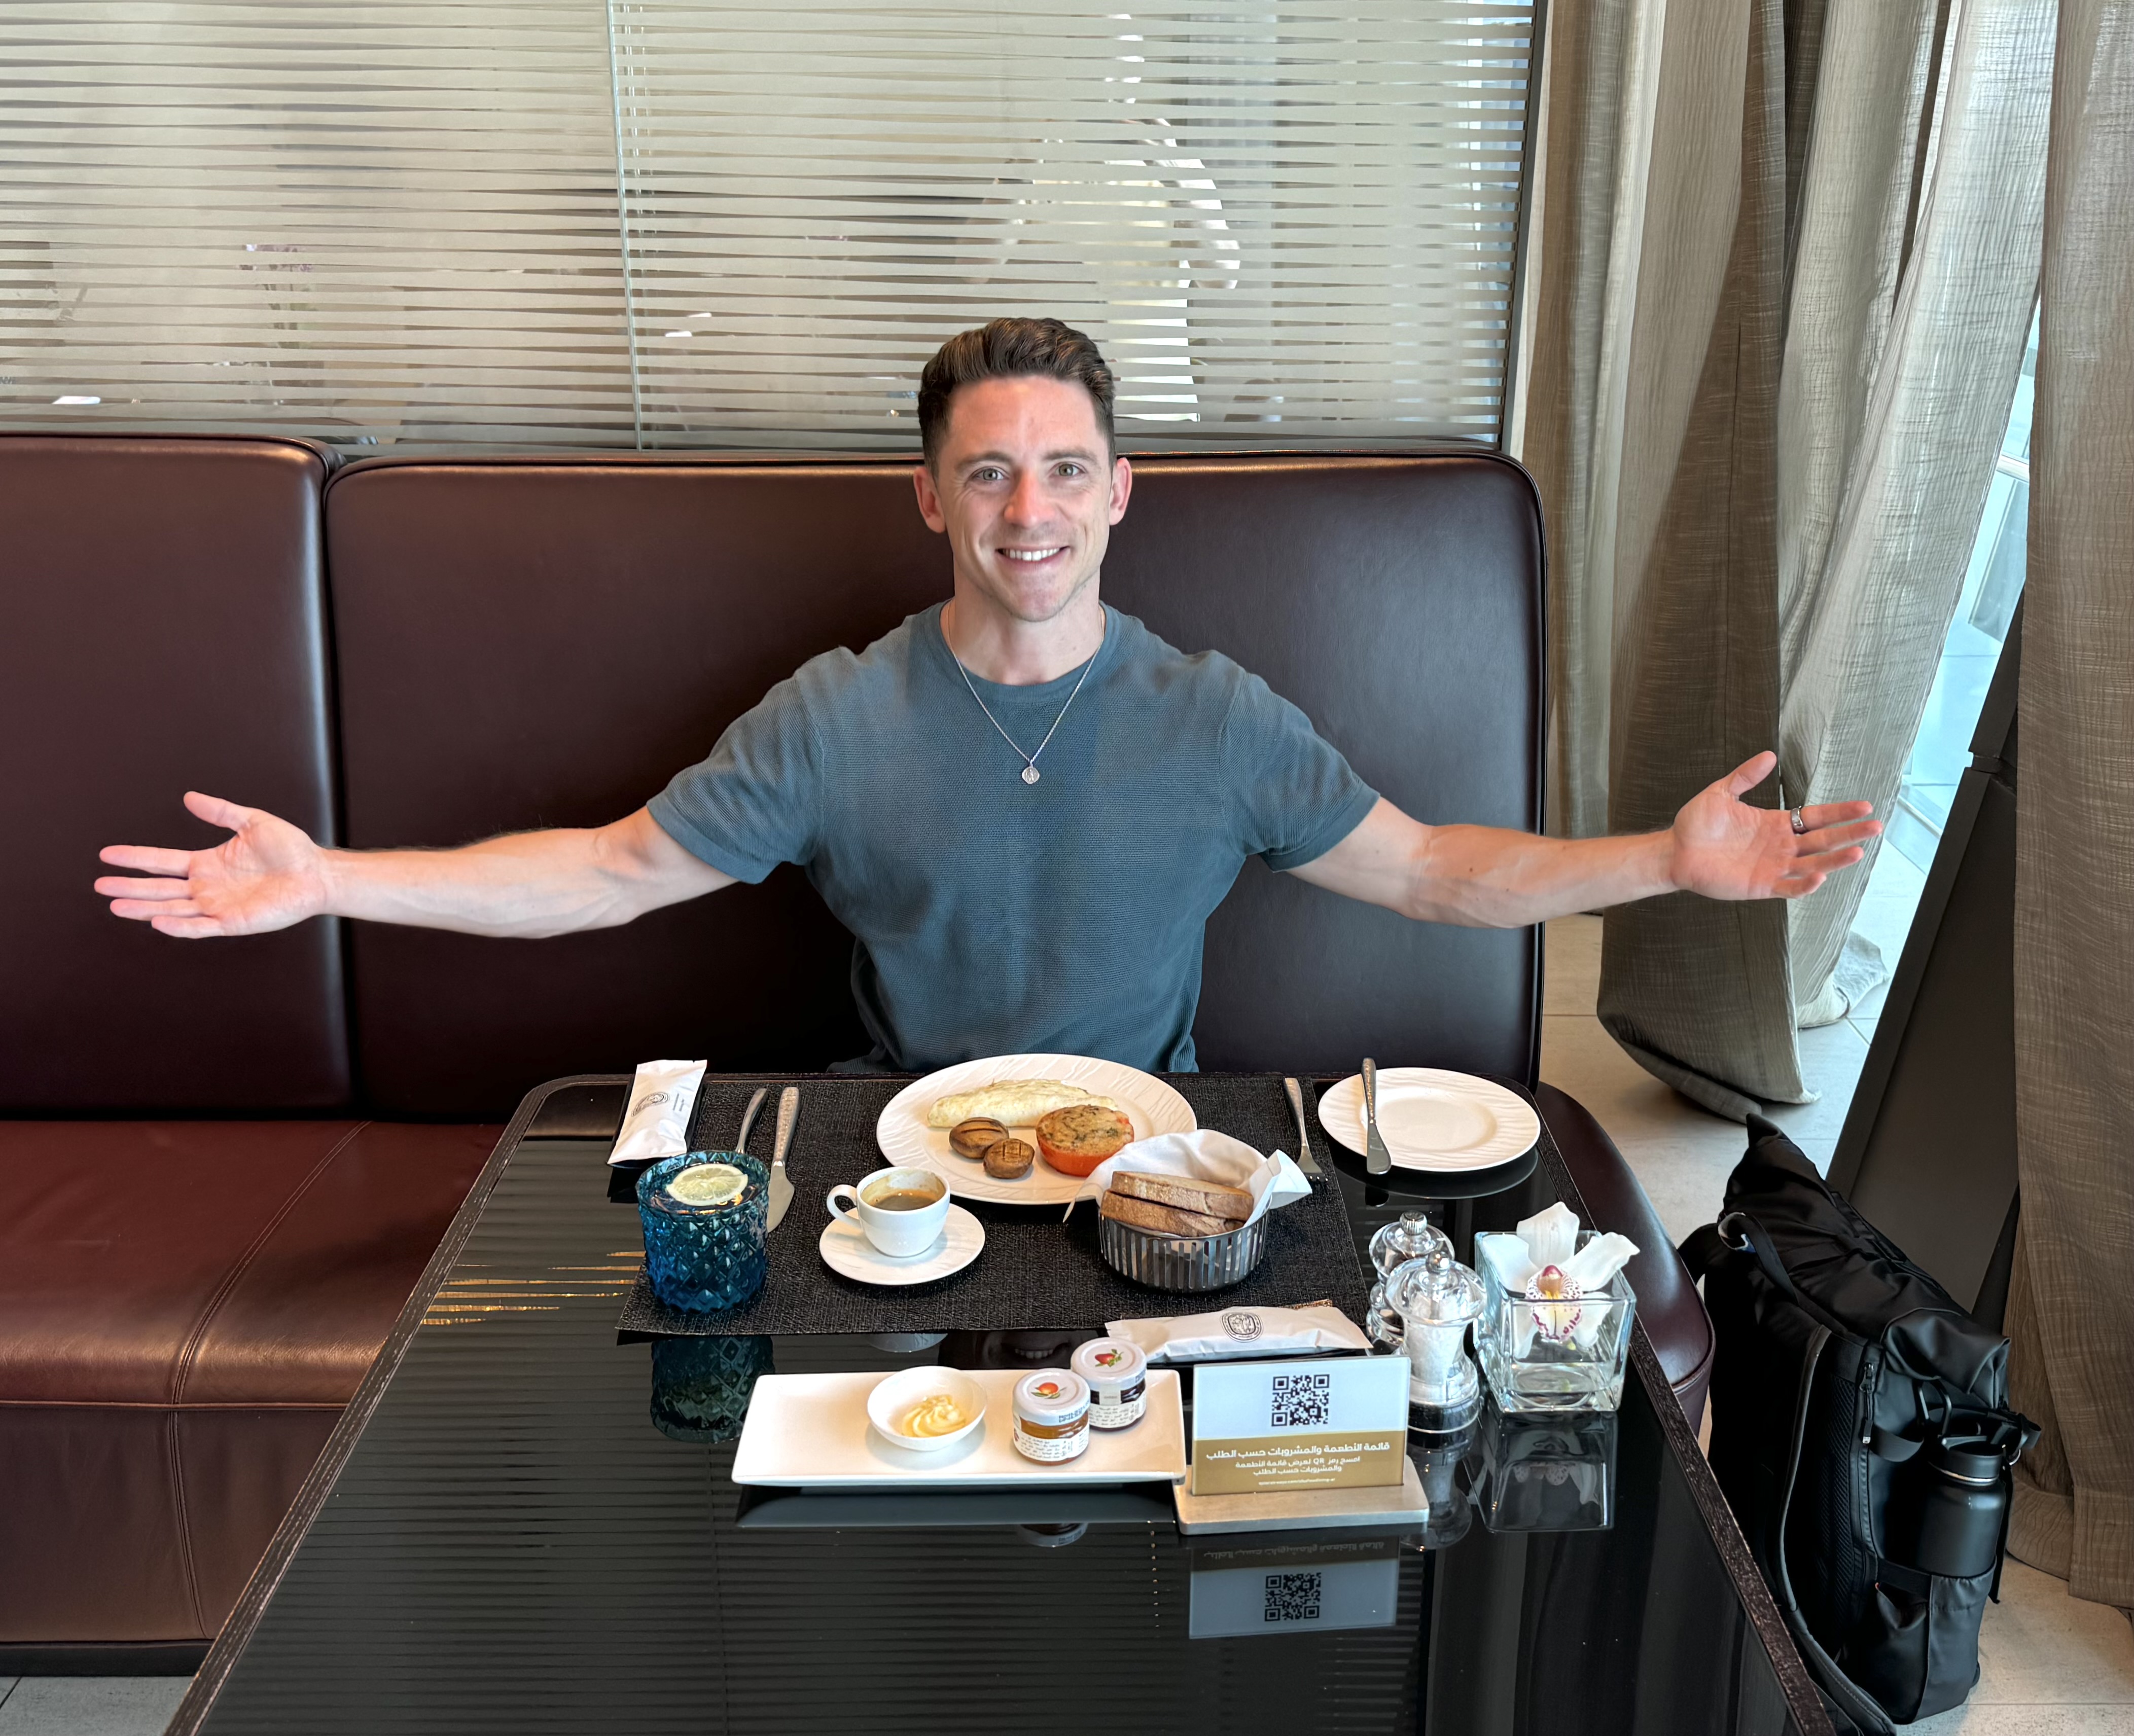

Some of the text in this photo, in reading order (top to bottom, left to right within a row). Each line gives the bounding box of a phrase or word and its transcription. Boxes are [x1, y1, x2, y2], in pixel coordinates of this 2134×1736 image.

[1206, 1442, 1390, 1460] قائمة الأطعمة والمشروبات حسب الطلب
